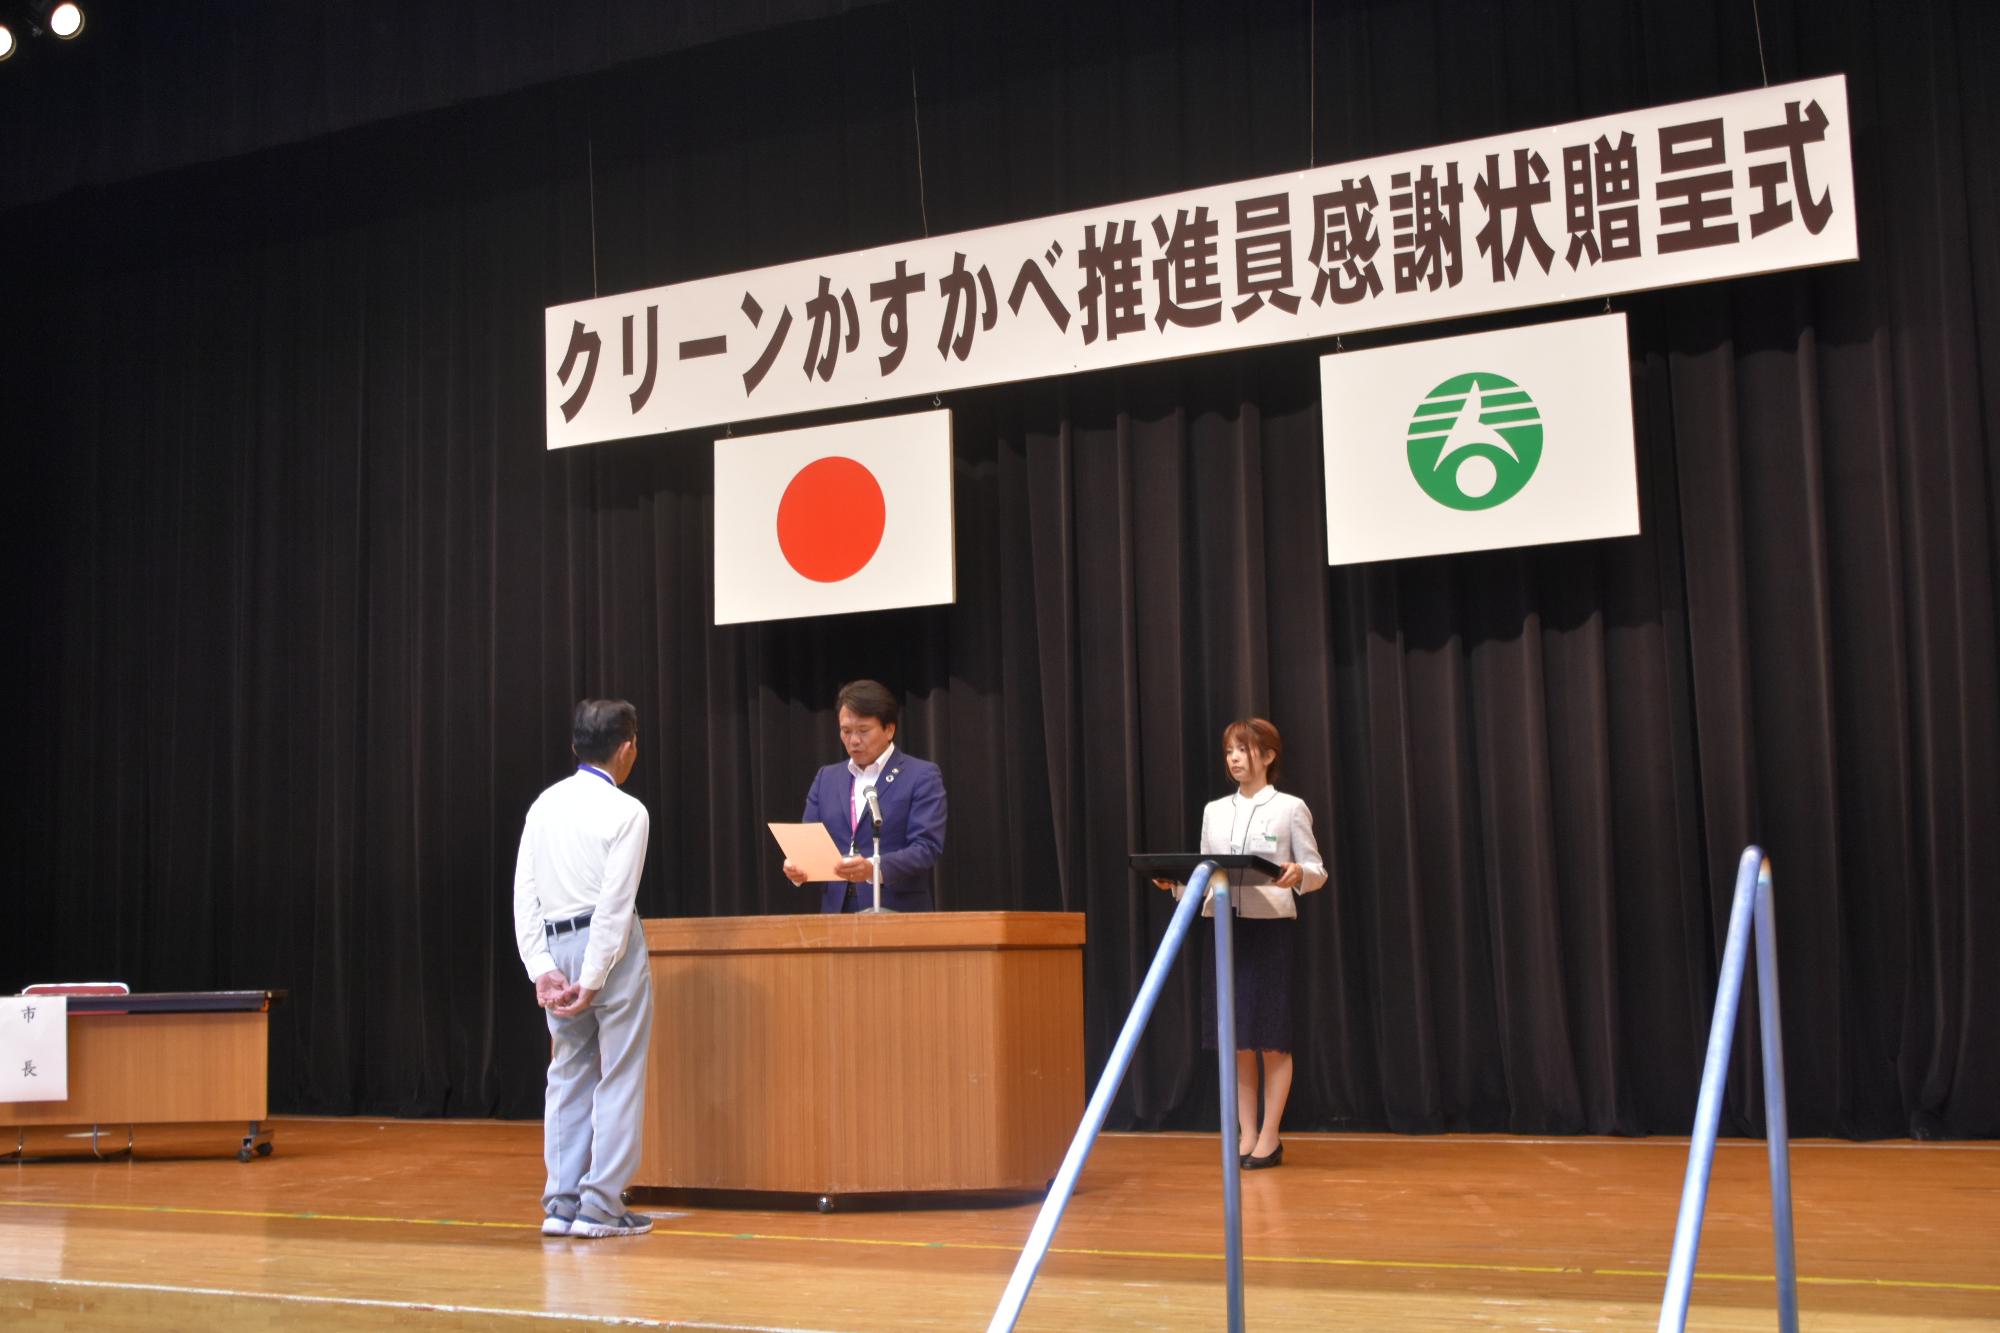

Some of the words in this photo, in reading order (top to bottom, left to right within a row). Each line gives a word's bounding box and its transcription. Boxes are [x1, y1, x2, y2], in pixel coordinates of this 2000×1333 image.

[556, 99, 1834, 424] クリーンかすかべ推進員感謝状贈呈式
[21, 1006, 38, 1077] 市長
